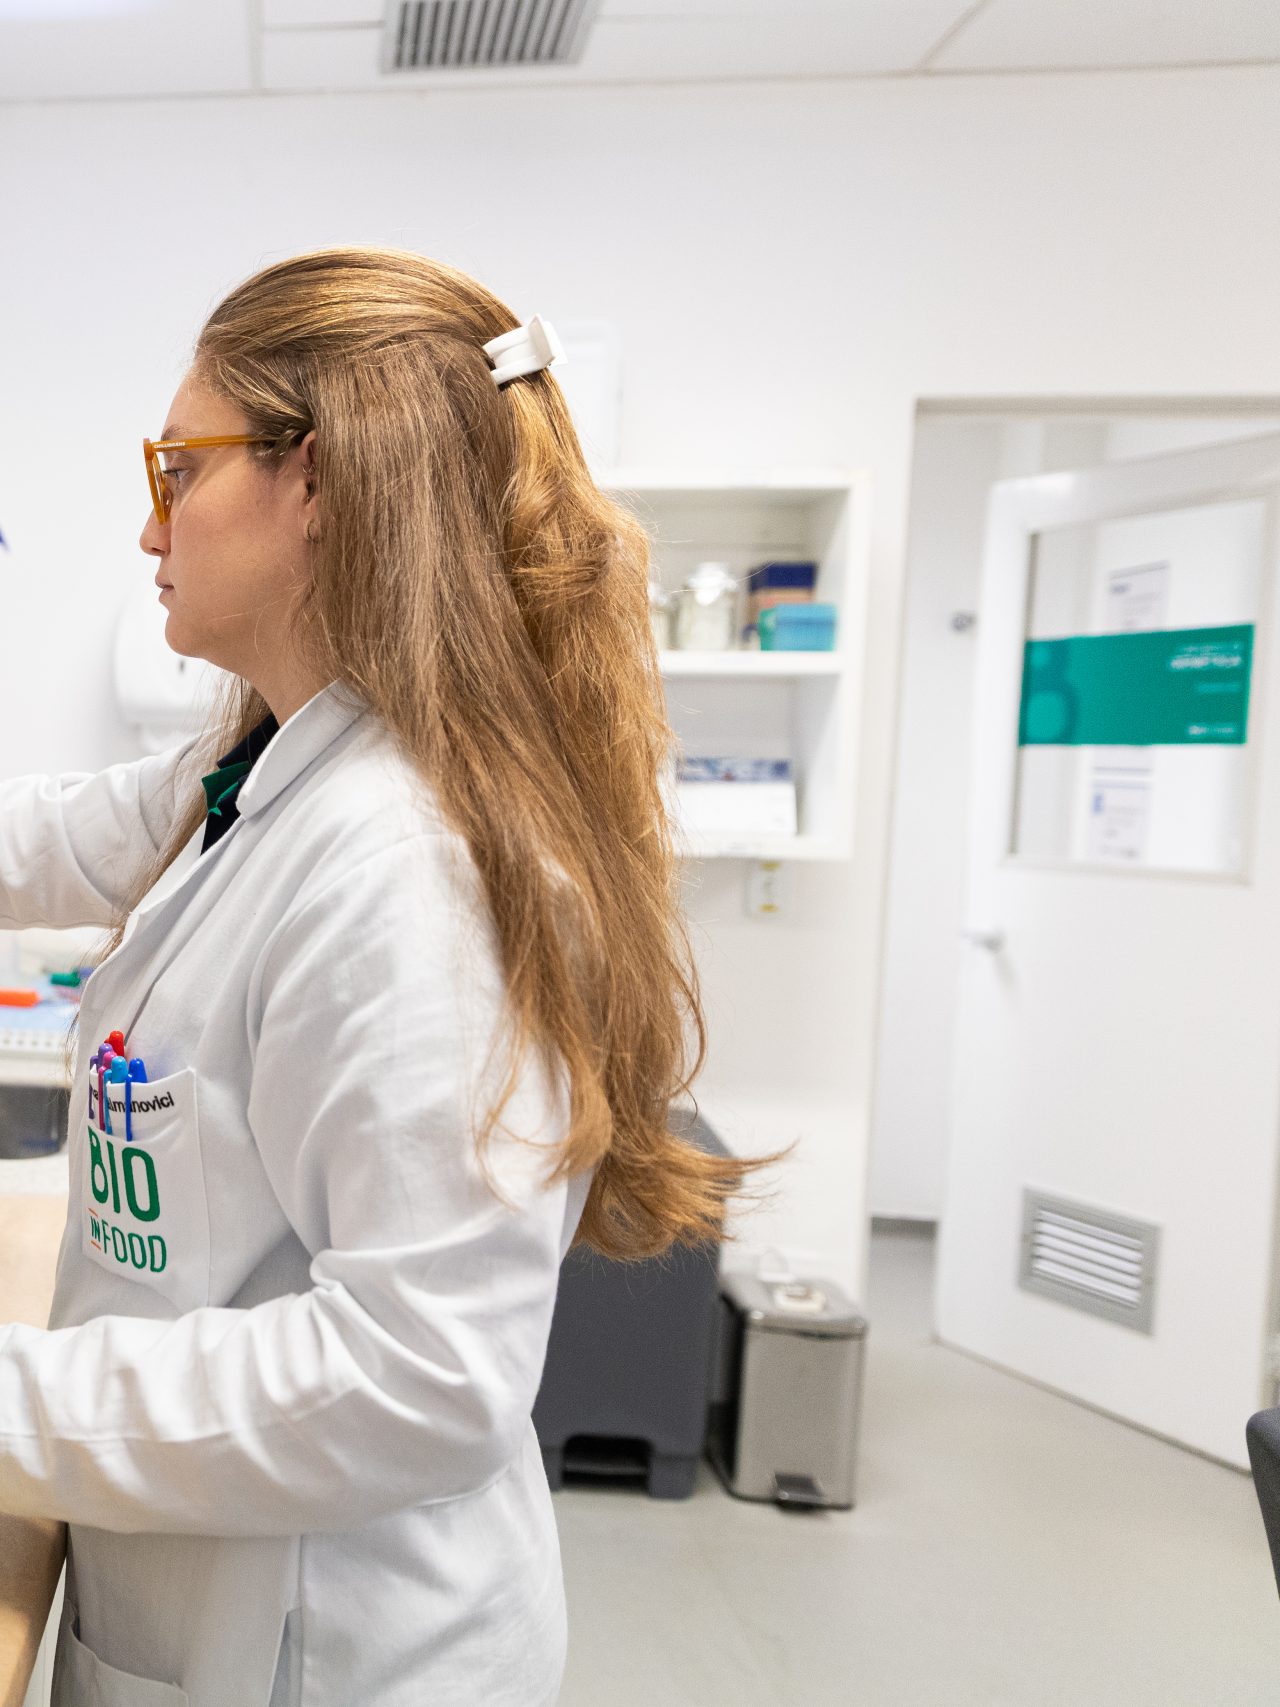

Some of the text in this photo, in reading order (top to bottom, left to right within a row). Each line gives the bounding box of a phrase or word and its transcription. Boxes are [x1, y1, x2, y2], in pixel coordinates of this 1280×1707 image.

[87, 1125, 161, 1222] BIO
[91, 1215, 168, 1274] IN FOOD
